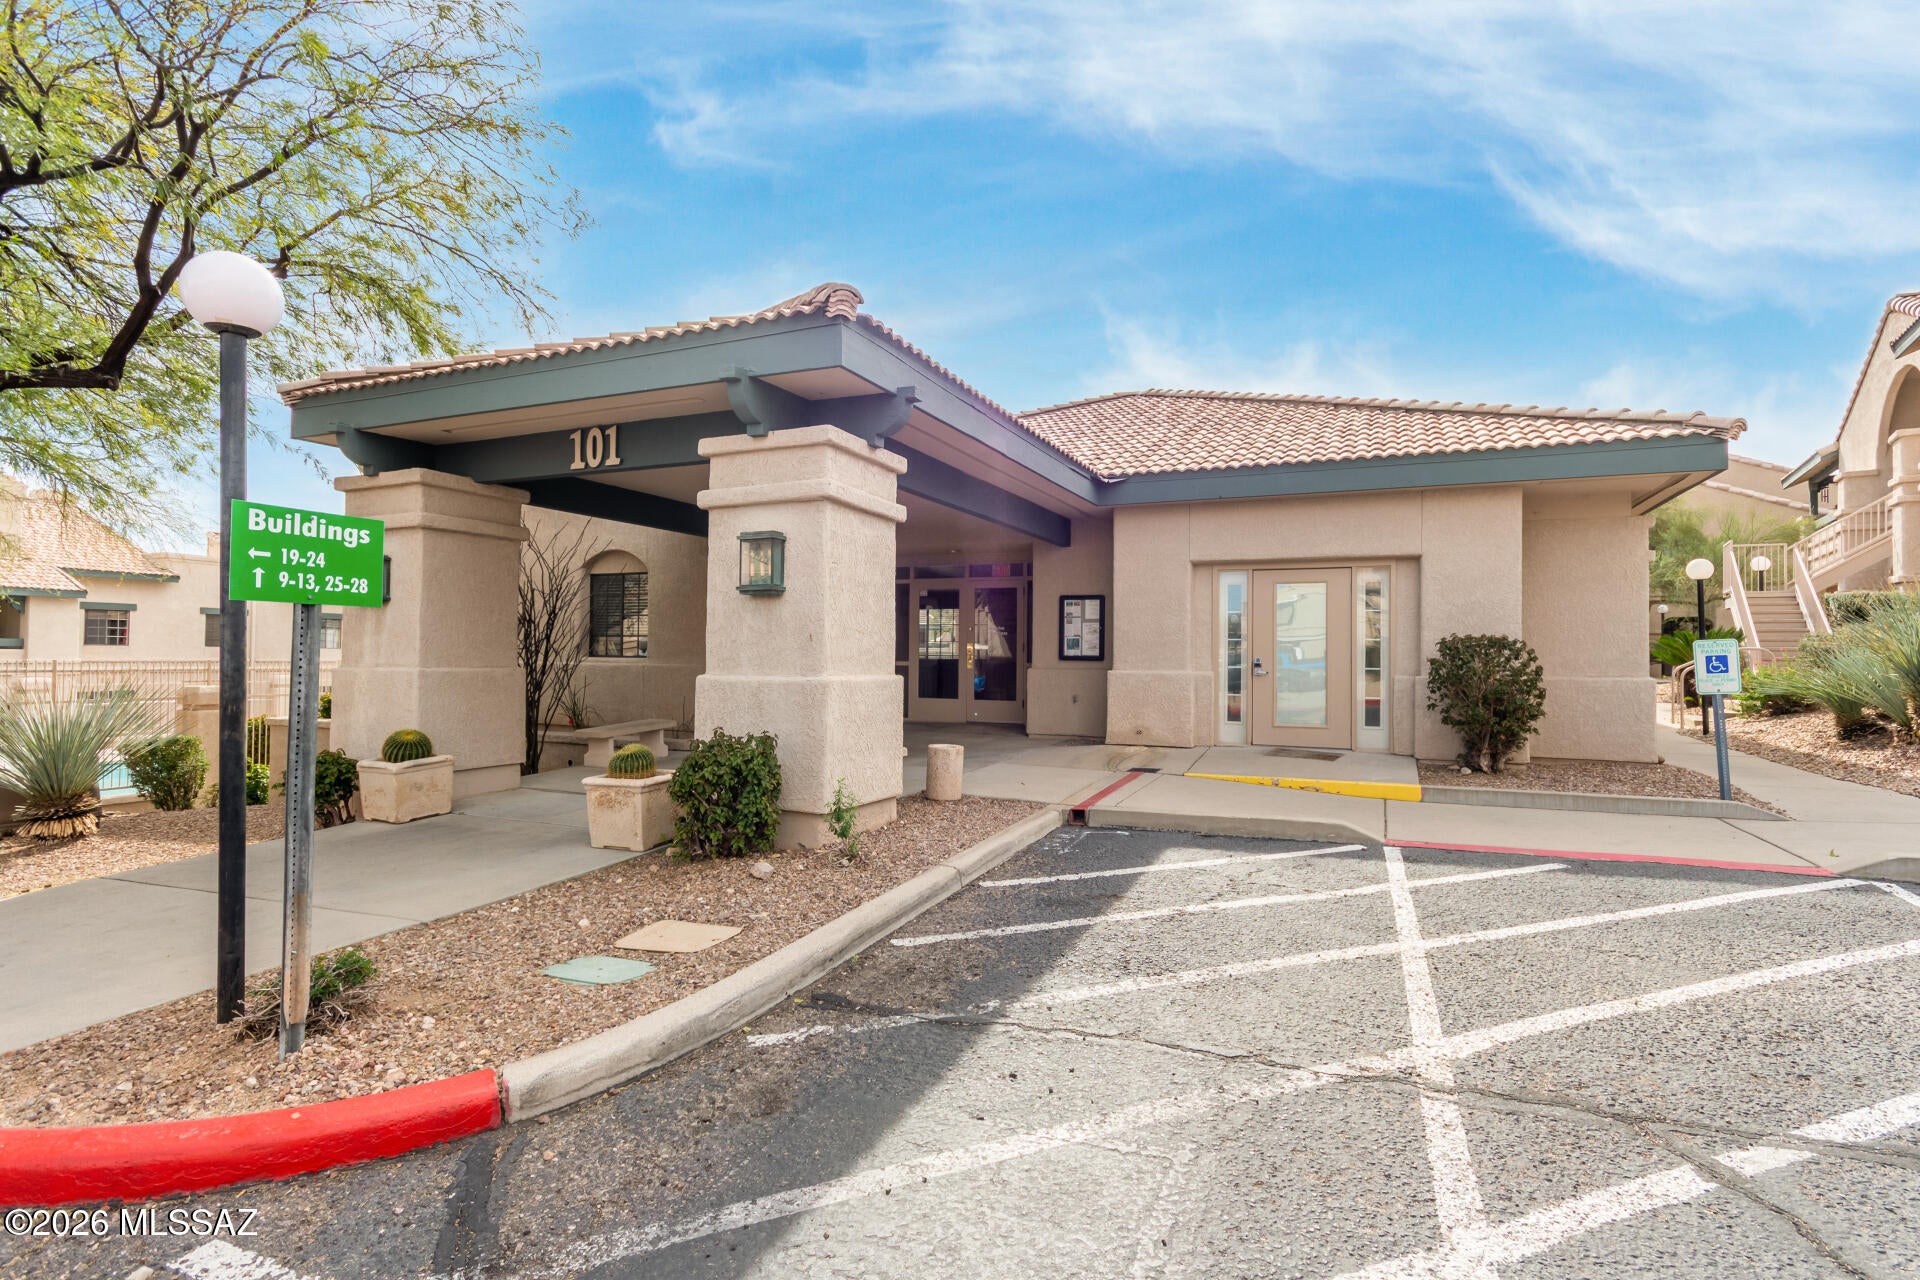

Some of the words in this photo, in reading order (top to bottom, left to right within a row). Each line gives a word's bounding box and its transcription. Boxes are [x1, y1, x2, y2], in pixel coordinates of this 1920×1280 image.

[569, 425, 621, 470] 101
[248, 508, 371, 548] Buildings
[281, 548, 326, 568] 19-24
[278, 571, 320, 593] 9-13,
[325, 575, 368, 594] 25-28
